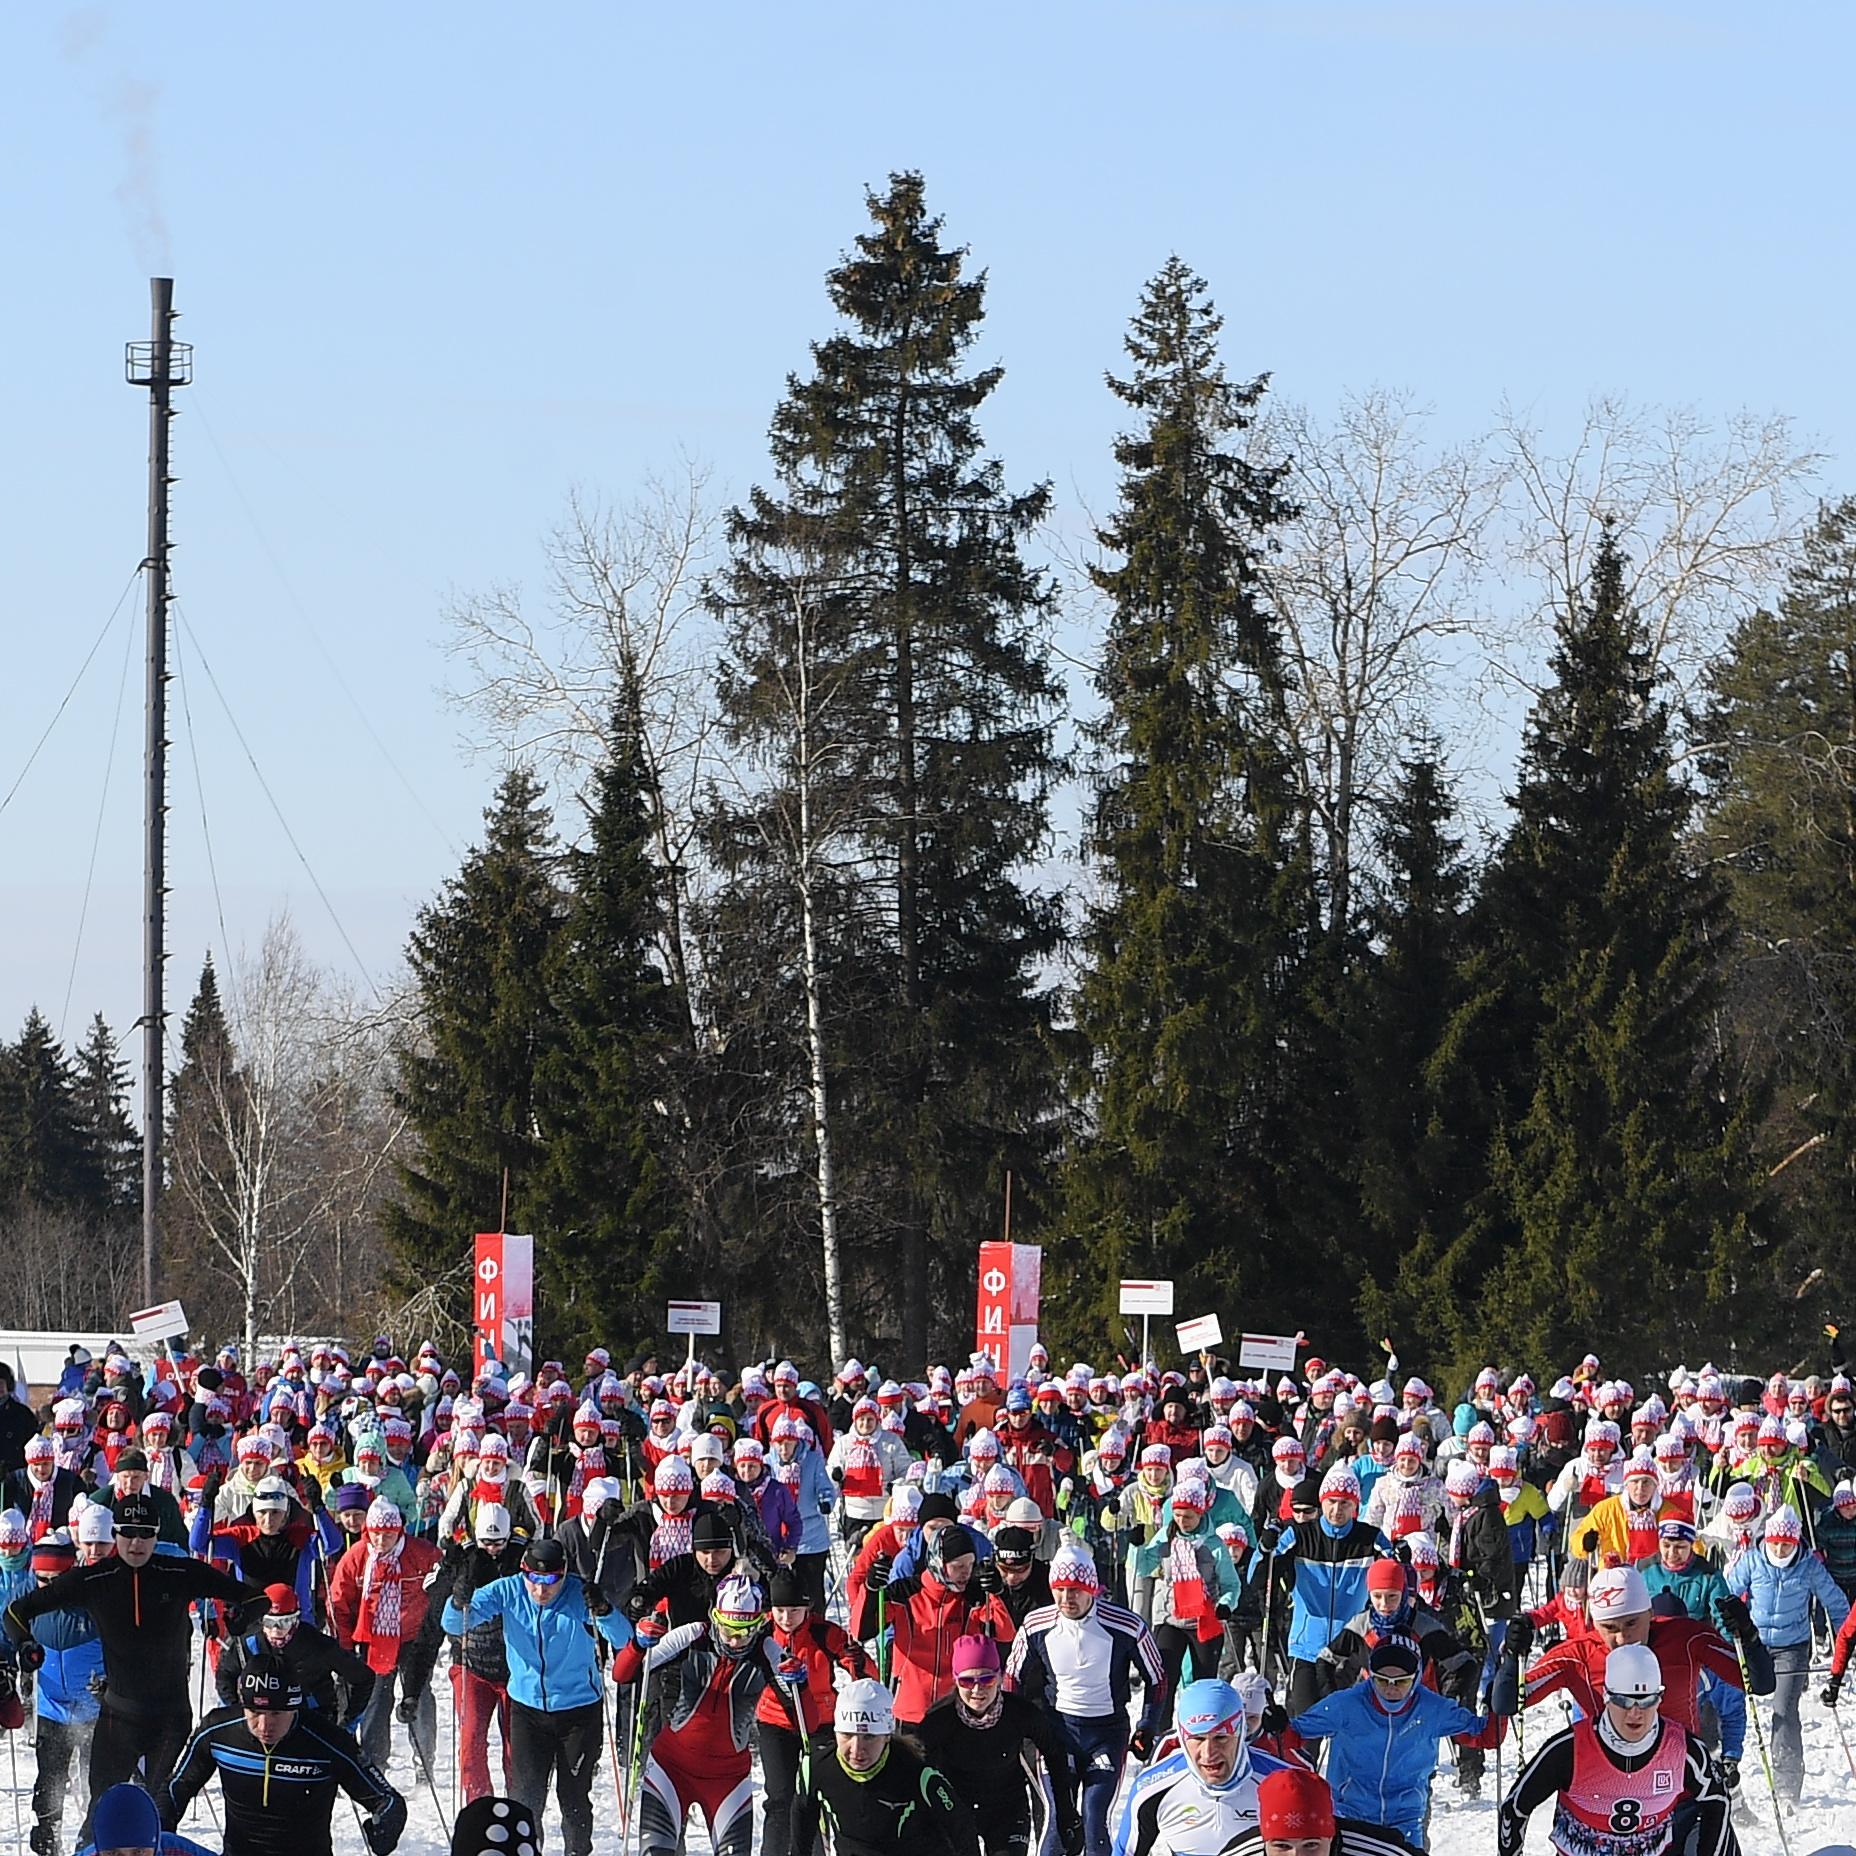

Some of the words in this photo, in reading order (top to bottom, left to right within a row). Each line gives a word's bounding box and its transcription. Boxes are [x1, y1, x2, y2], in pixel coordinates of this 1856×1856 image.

[245, 1673, 281, 1693] DNB
[274, 1762, 305, 1775] CRAFT
[1609, 1798, 1643, 1834] 8
